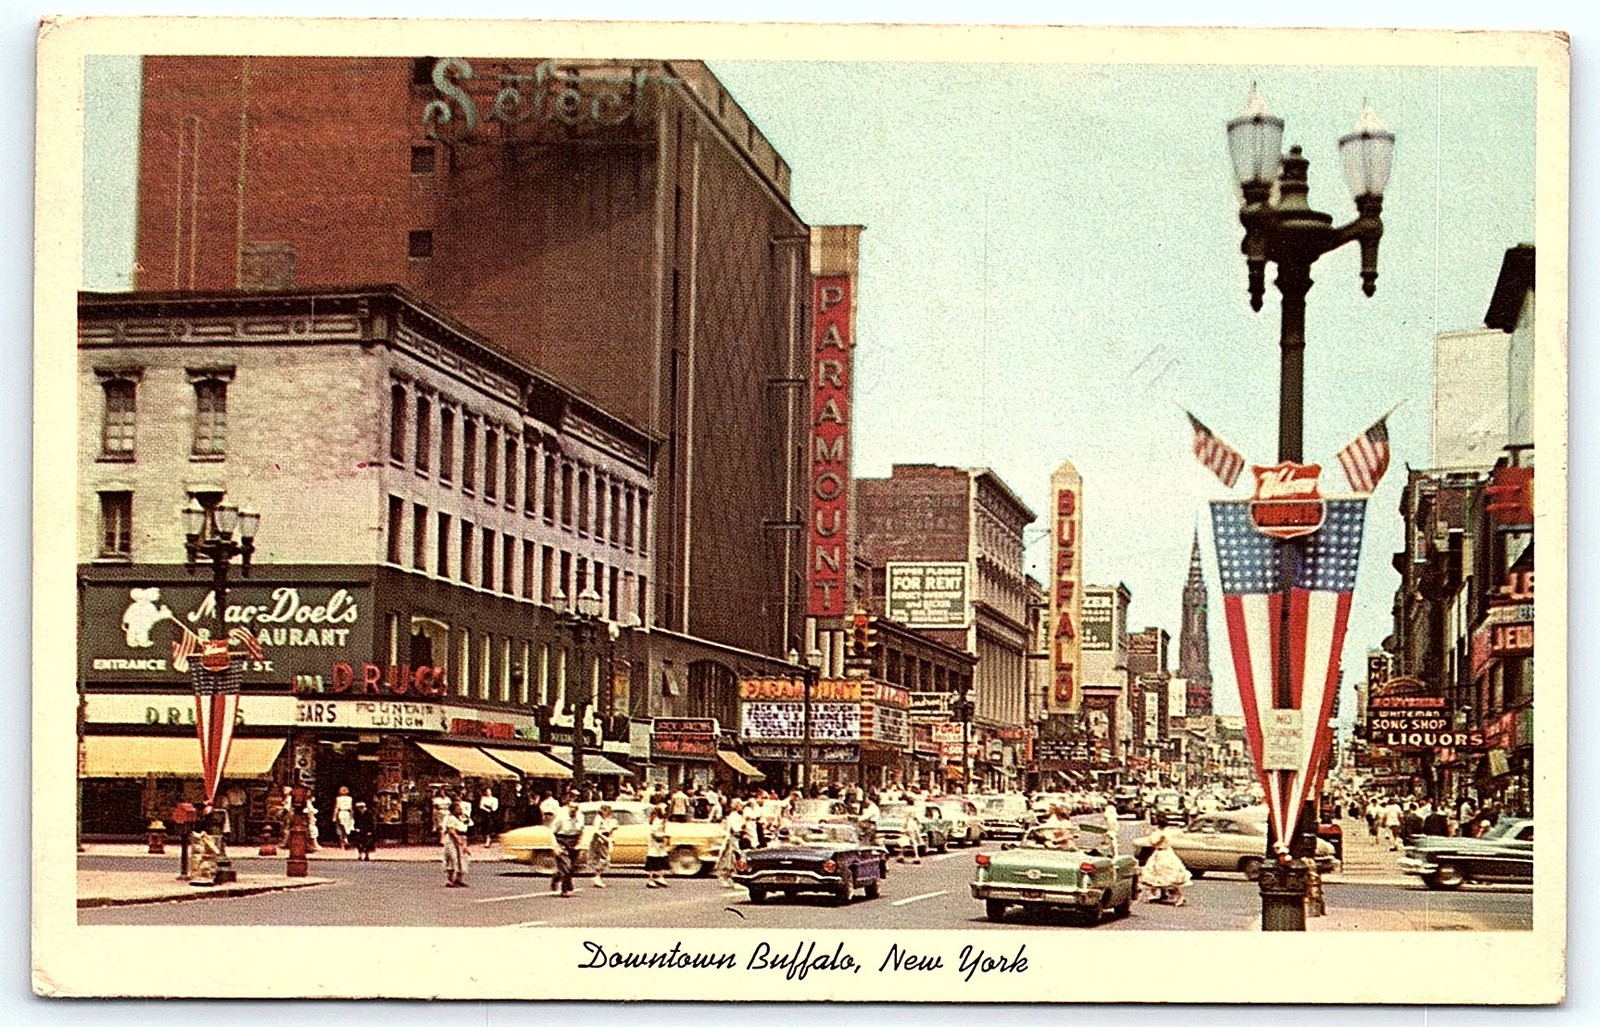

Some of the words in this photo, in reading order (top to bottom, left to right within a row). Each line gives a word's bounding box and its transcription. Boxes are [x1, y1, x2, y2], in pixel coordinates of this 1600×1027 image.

[814, 285, 846, 611] PARAMOUNT
[893, 576, 921, 590] FOR
[925, 576, 963, 590] RENT
[1055, 489, 1076, 701] BUFFALO
[198, 628, 350, 647] RSAURANT
[93, 659, 167, 670] ENTRANCE
[146, 706, 245, 725] DRUS
[1372, 719, 1408, 730] SONG
[1411, 719, 1447, 730] SHOP
[1388, 732, 1484, 747] LIQUORS
